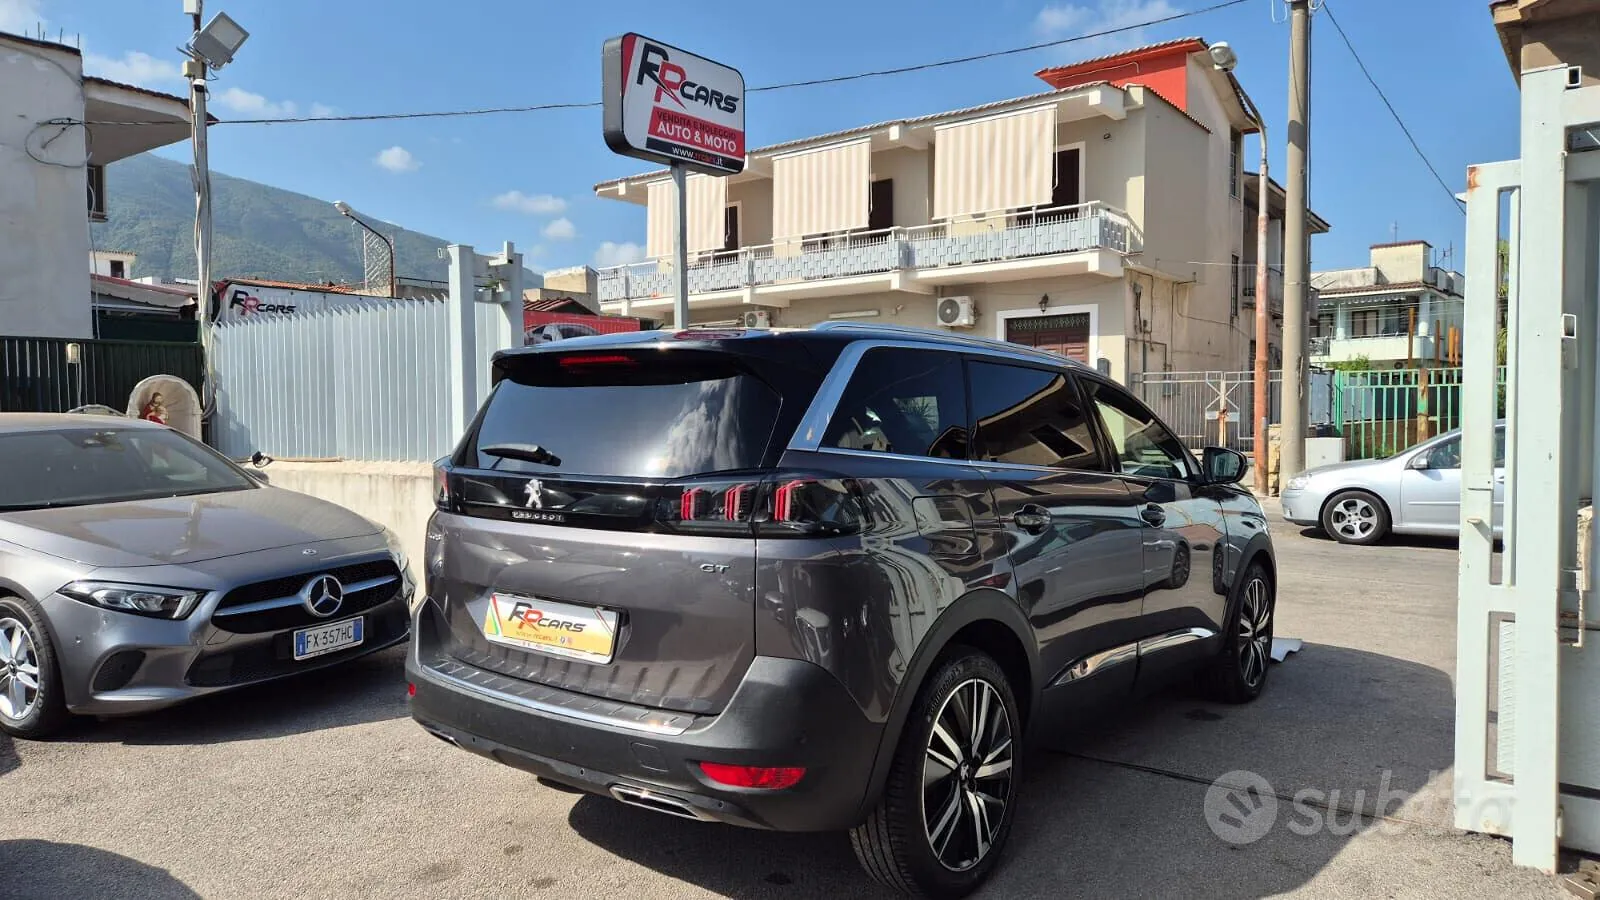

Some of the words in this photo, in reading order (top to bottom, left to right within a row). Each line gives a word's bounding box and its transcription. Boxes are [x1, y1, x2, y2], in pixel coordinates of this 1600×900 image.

[657, 111, 691, 127] VENDITA
[657, 121, 691, 140] AUTO
[694, 130, 702, 143] &
[704, 133, 736, 153] MOTO
[700, 563, 730, 574] GT
